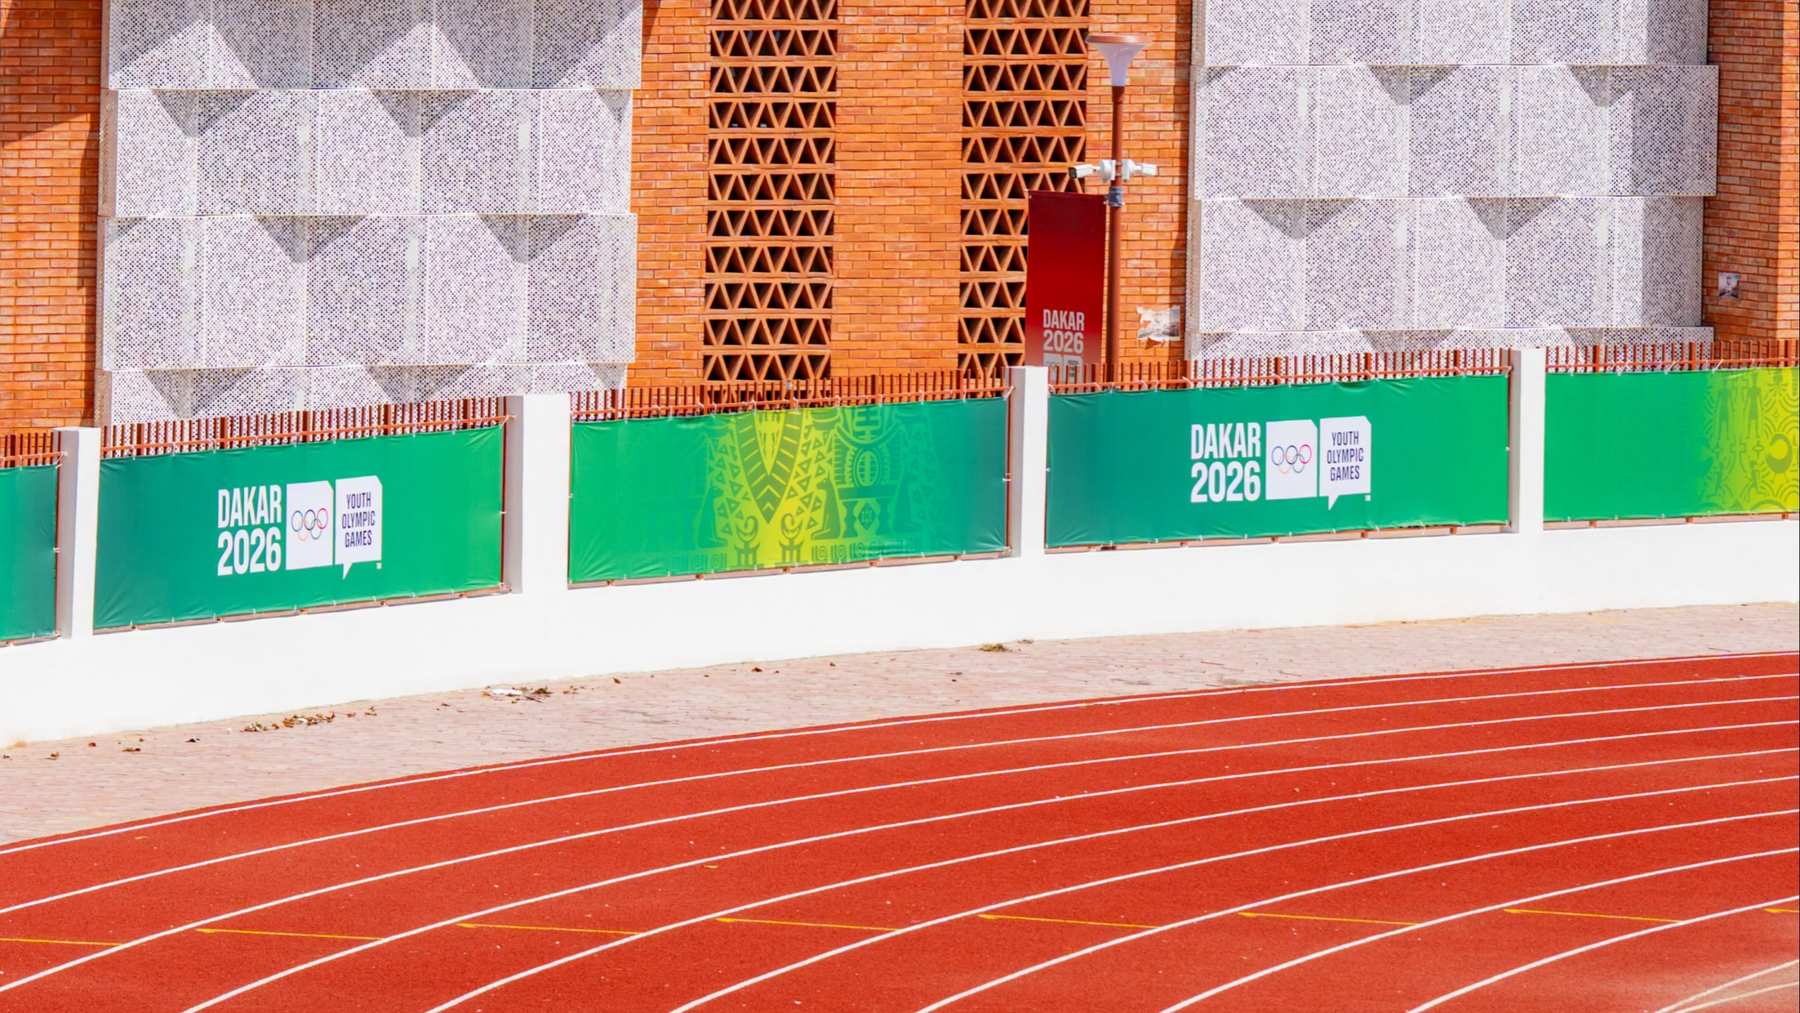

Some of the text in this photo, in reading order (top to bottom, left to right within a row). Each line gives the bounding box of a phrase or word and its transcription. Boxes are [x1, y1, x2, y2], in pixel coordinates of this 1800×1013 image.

[1043, 309, 1085, 331] DAKAR
[1043, 329, 1084, 353] 2026
[1190, 422, 1261, 460] DAKAR
[1331, 431, 1360, 446] YOUTH
[1326, 448, 1364, 464] OLYMPIC
[1190, 460, 1261, 503] 2026
[1330, 466, 1360, 482] GAMES
[217, 484, 282, 528] DAKAR
[346, 492, 372, 509] YOUTH
[341, 511, 376, 529] OLYMPIC
[344, 530, 373, 548] GAMES
[217, 527, 282, 576] 2026
